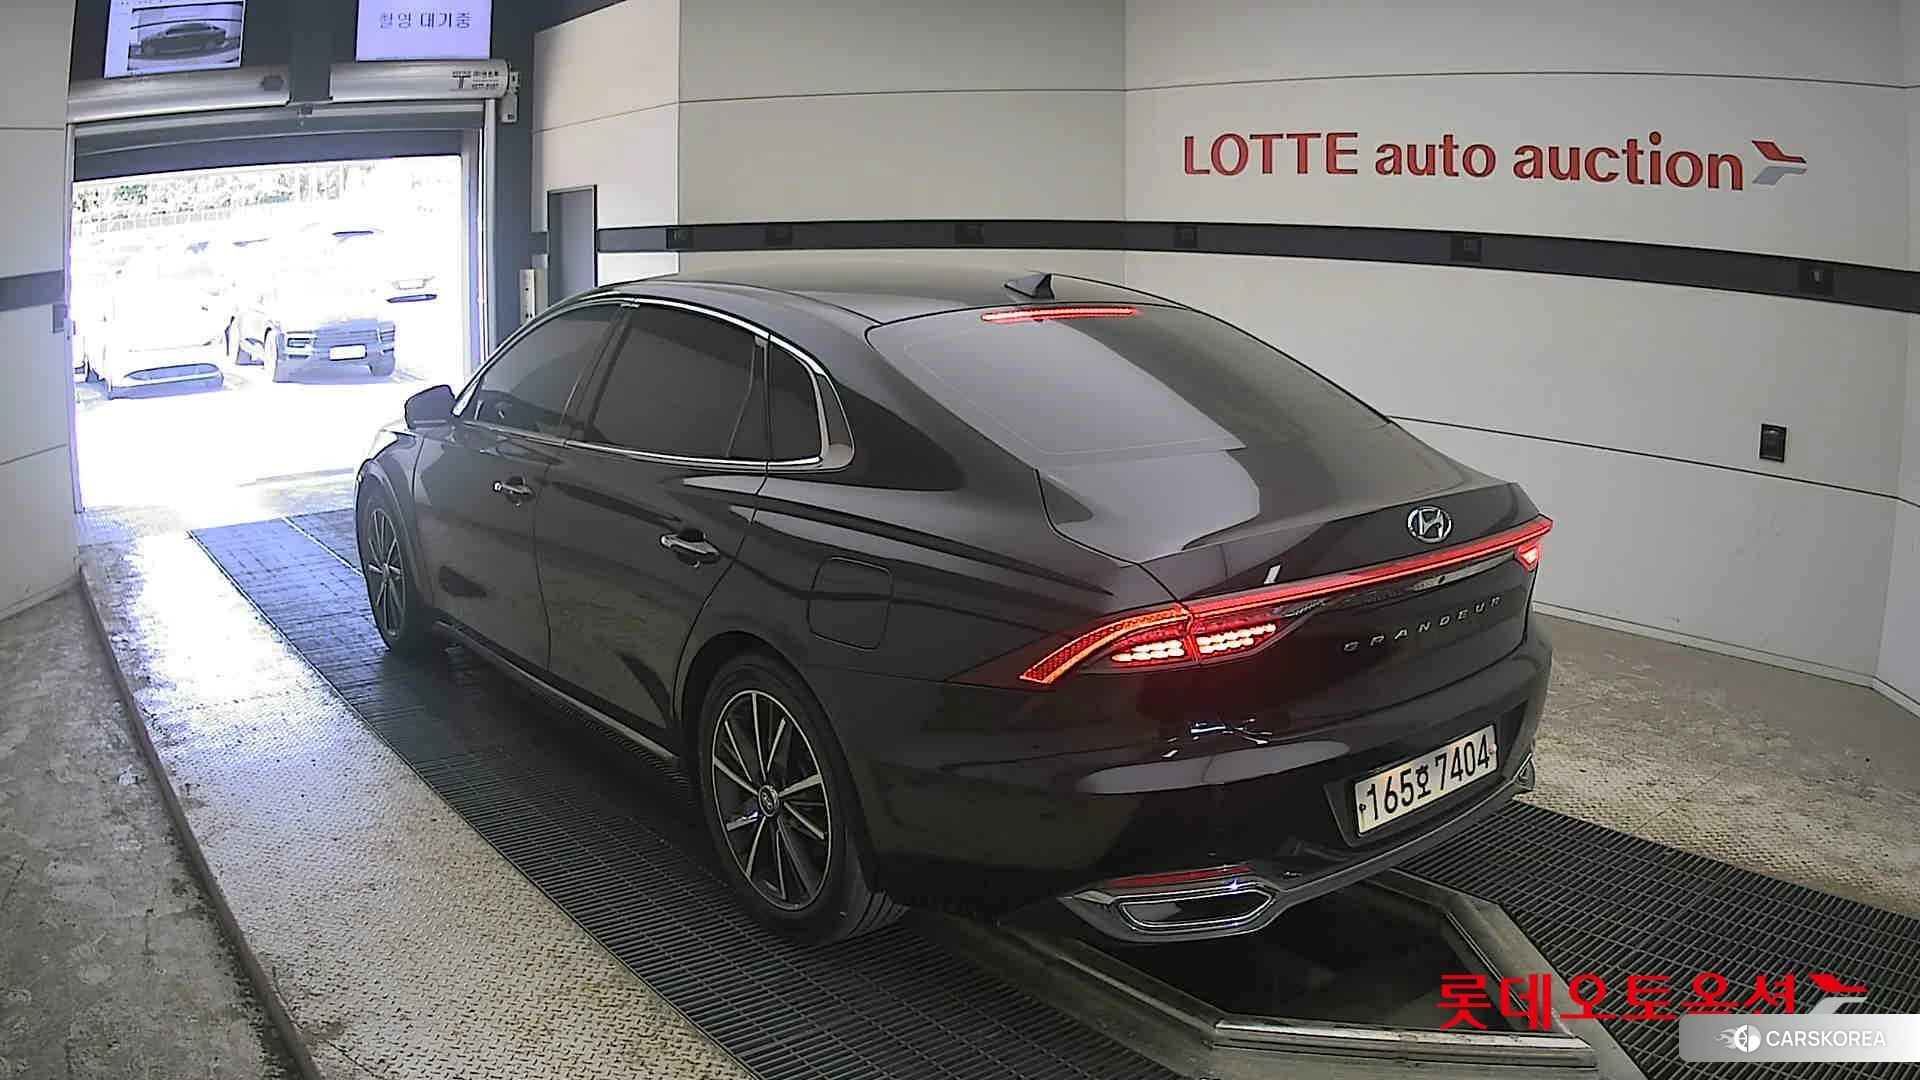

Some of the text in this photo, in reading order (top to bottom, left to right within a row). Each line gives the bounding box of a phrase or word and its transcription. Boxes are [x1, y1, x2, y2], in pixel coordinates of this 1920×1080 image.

[1184, 131, 1745, 191] LOTTE auto auction
[1343, 596, 1501, 652] GRANDEUR
